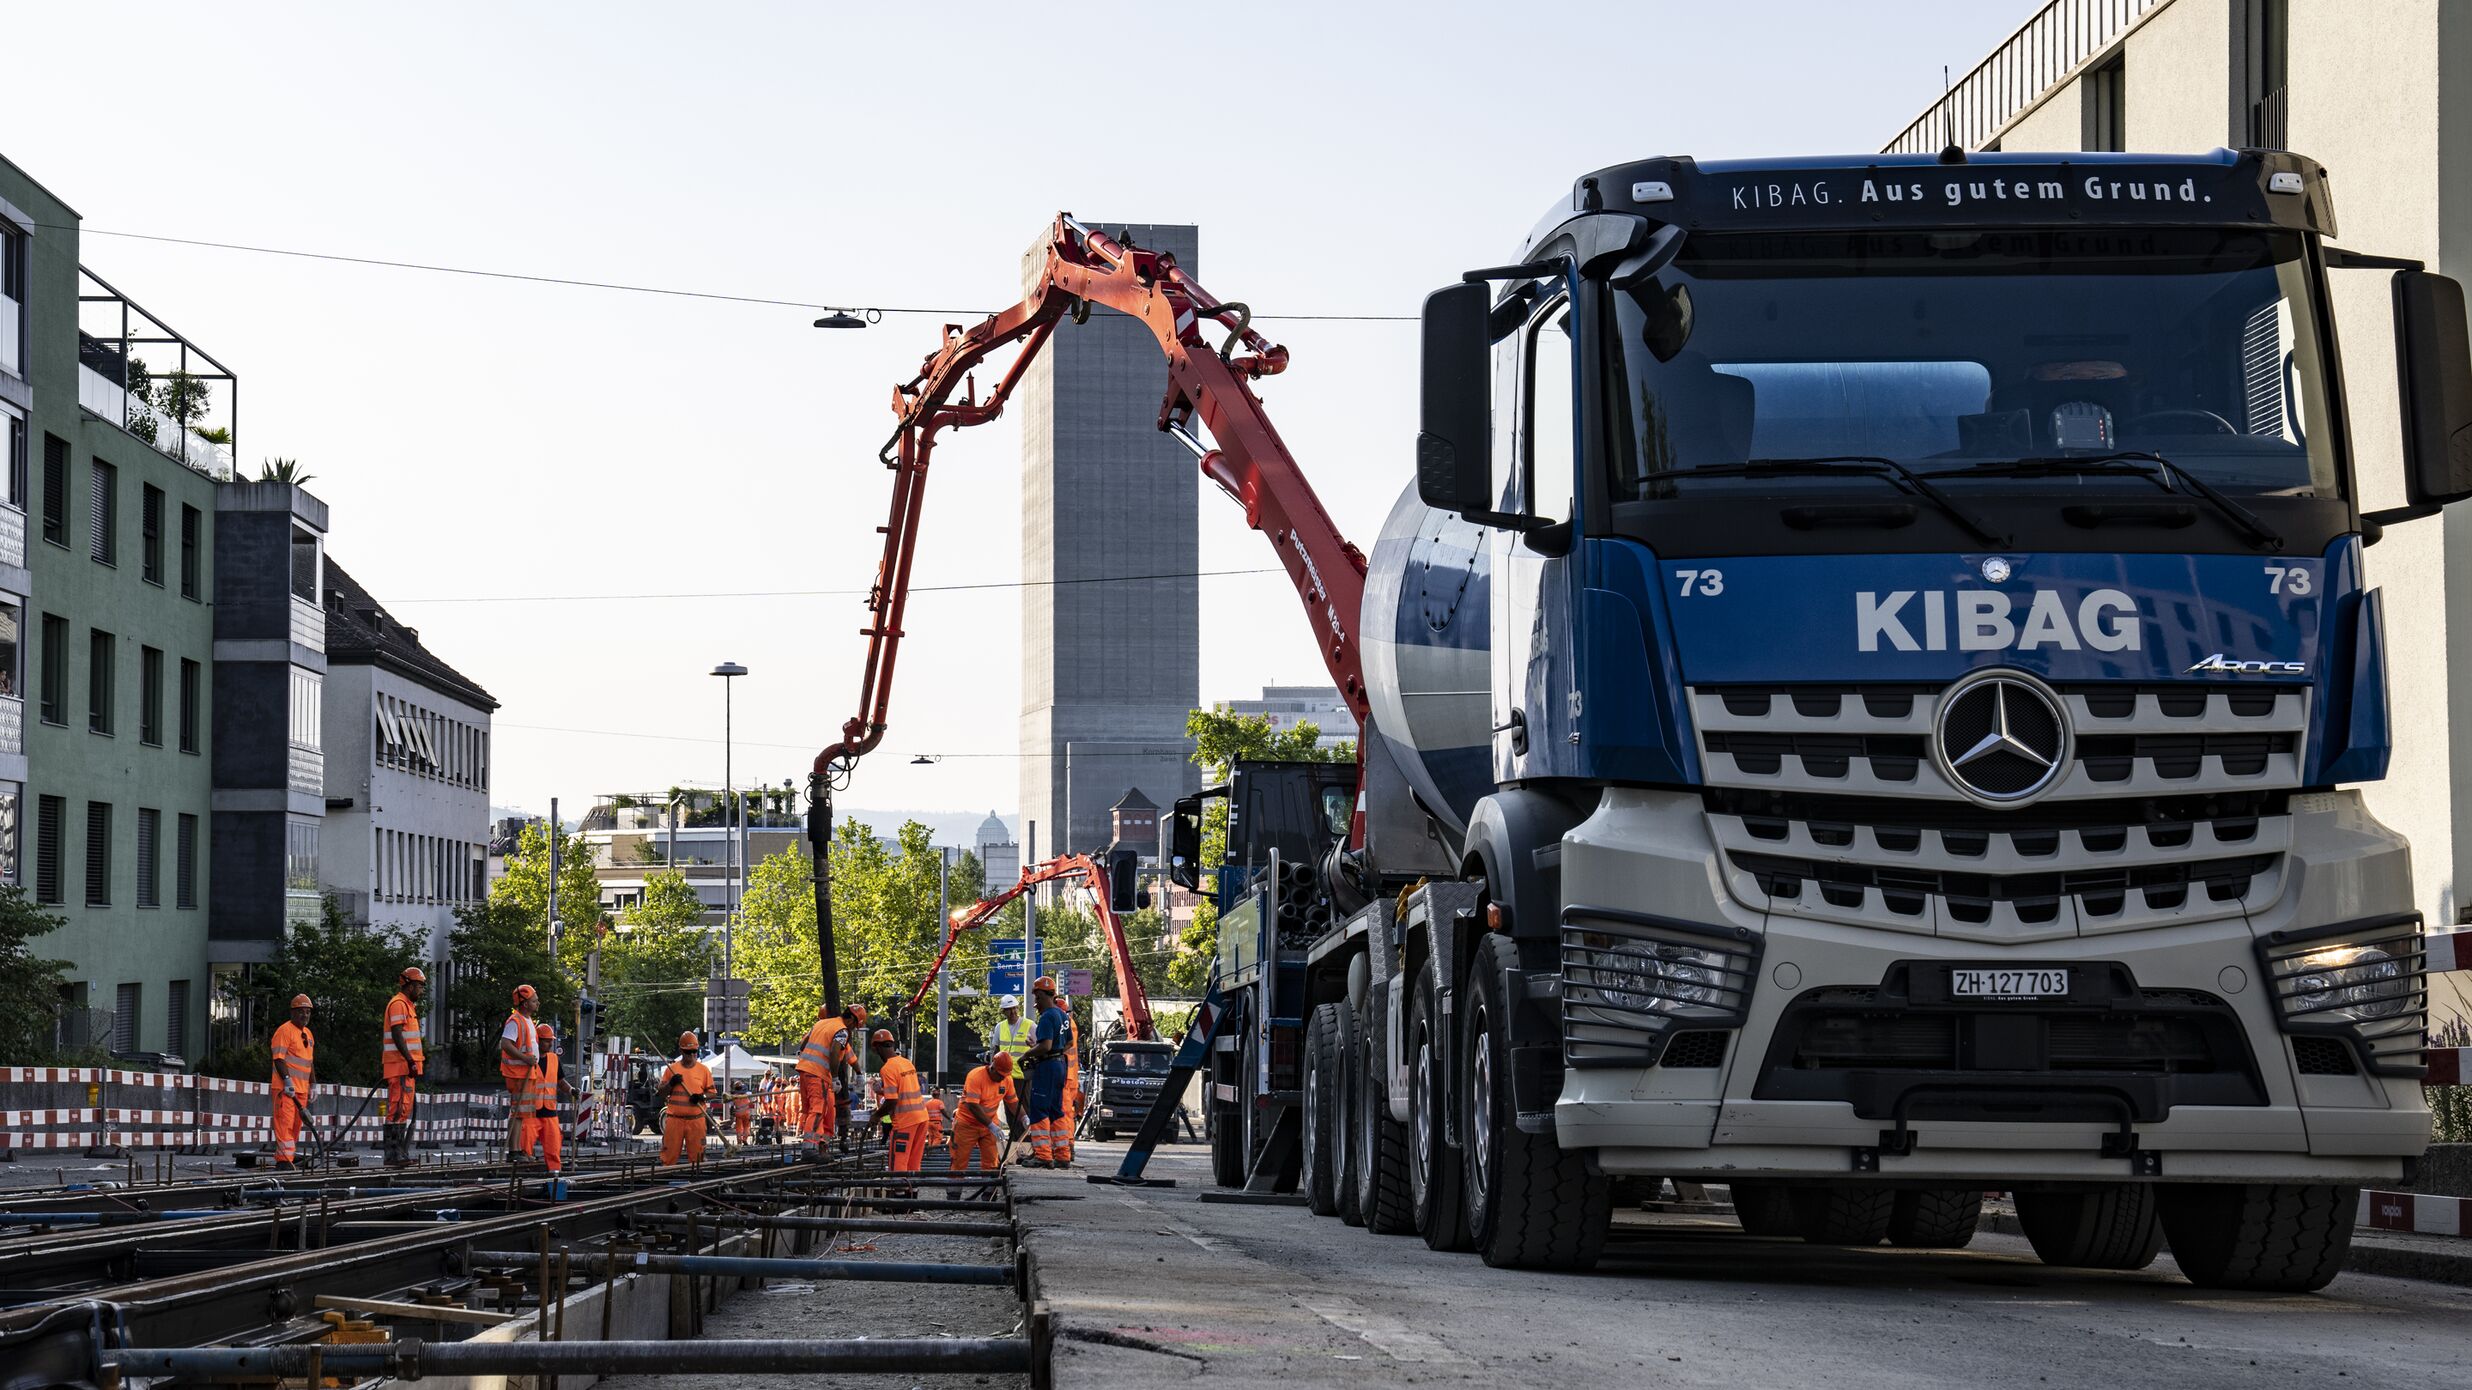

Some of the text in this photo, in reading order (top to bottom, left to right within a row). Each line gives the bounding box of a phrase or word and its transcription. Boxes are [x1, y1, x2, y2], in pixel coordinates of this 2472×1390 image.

[1733, 176, 2212, 209] KIBAG. Aus gutem Grund.
[1290, 528, 1326, 602] Putzmeister
[1676, 570, 1724, 597] 73
[2264, 567, 2311, 595] 73
[1856, 588, 2141, 652] KIBAG
[1568, 690, 1582, 719] 73
